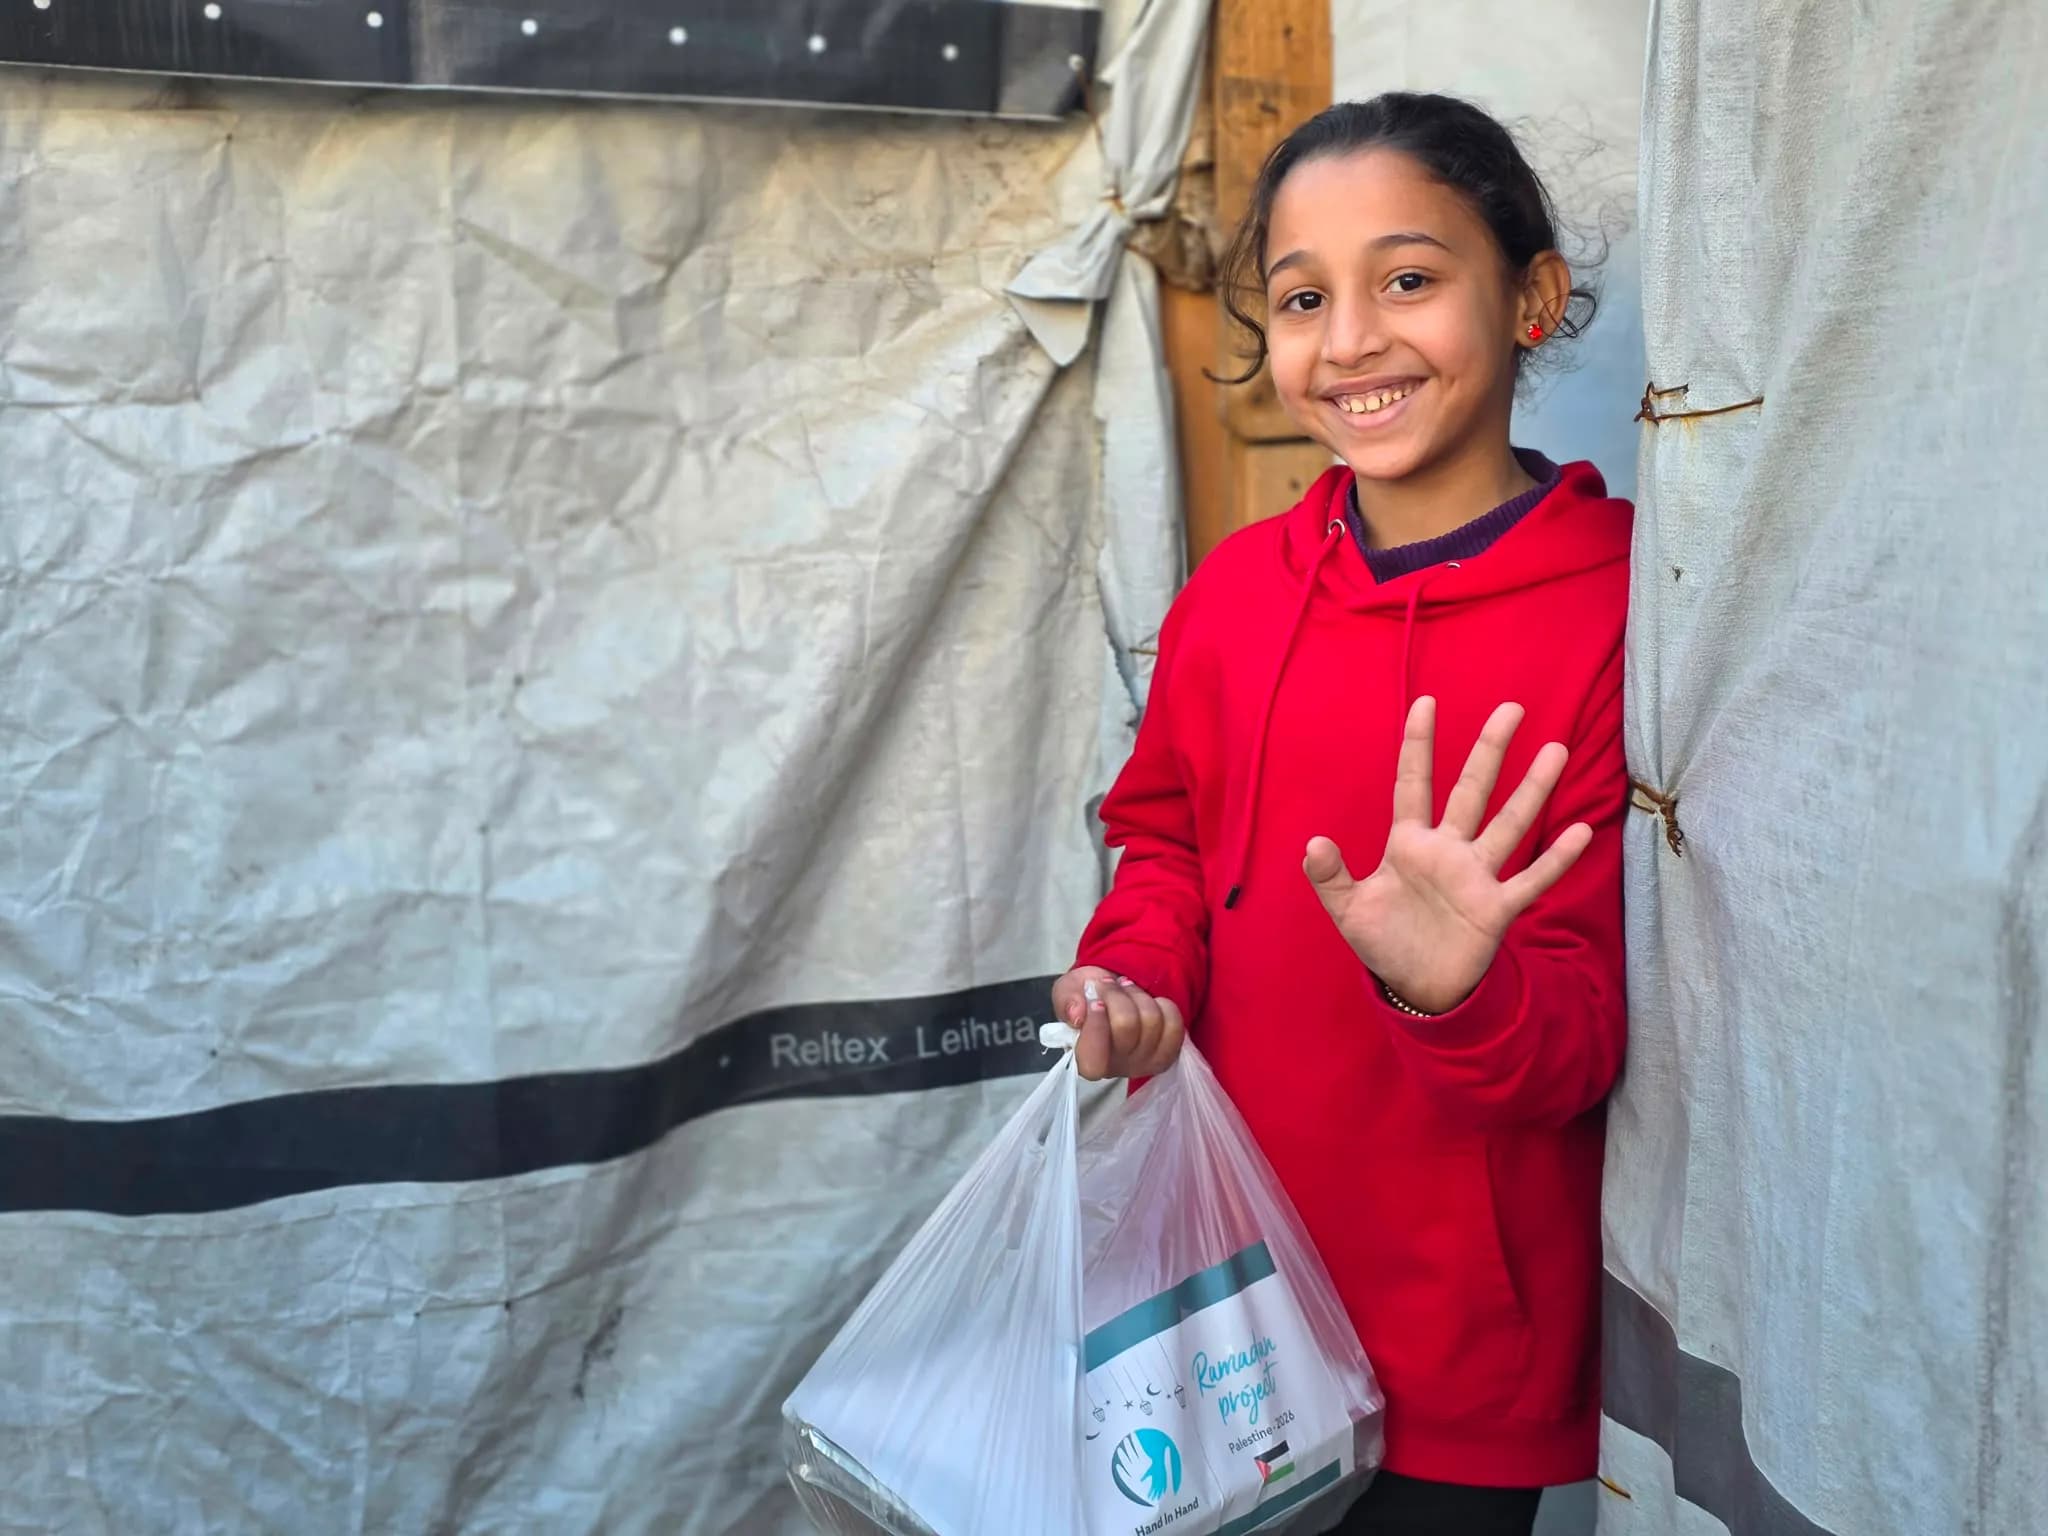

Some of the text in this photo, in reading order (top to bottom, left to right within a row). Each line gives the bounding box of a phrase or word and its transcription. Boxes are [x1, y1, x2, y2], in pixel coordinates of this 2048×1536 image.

[770, 1015, 1036, 1069] Reltex Leihua
[1192, 1328, 1277, 1398] Ramadan
[1218, 1361, 1279, 1426] project
[1135, 1496, 1199, 1536] Hand In Hand
